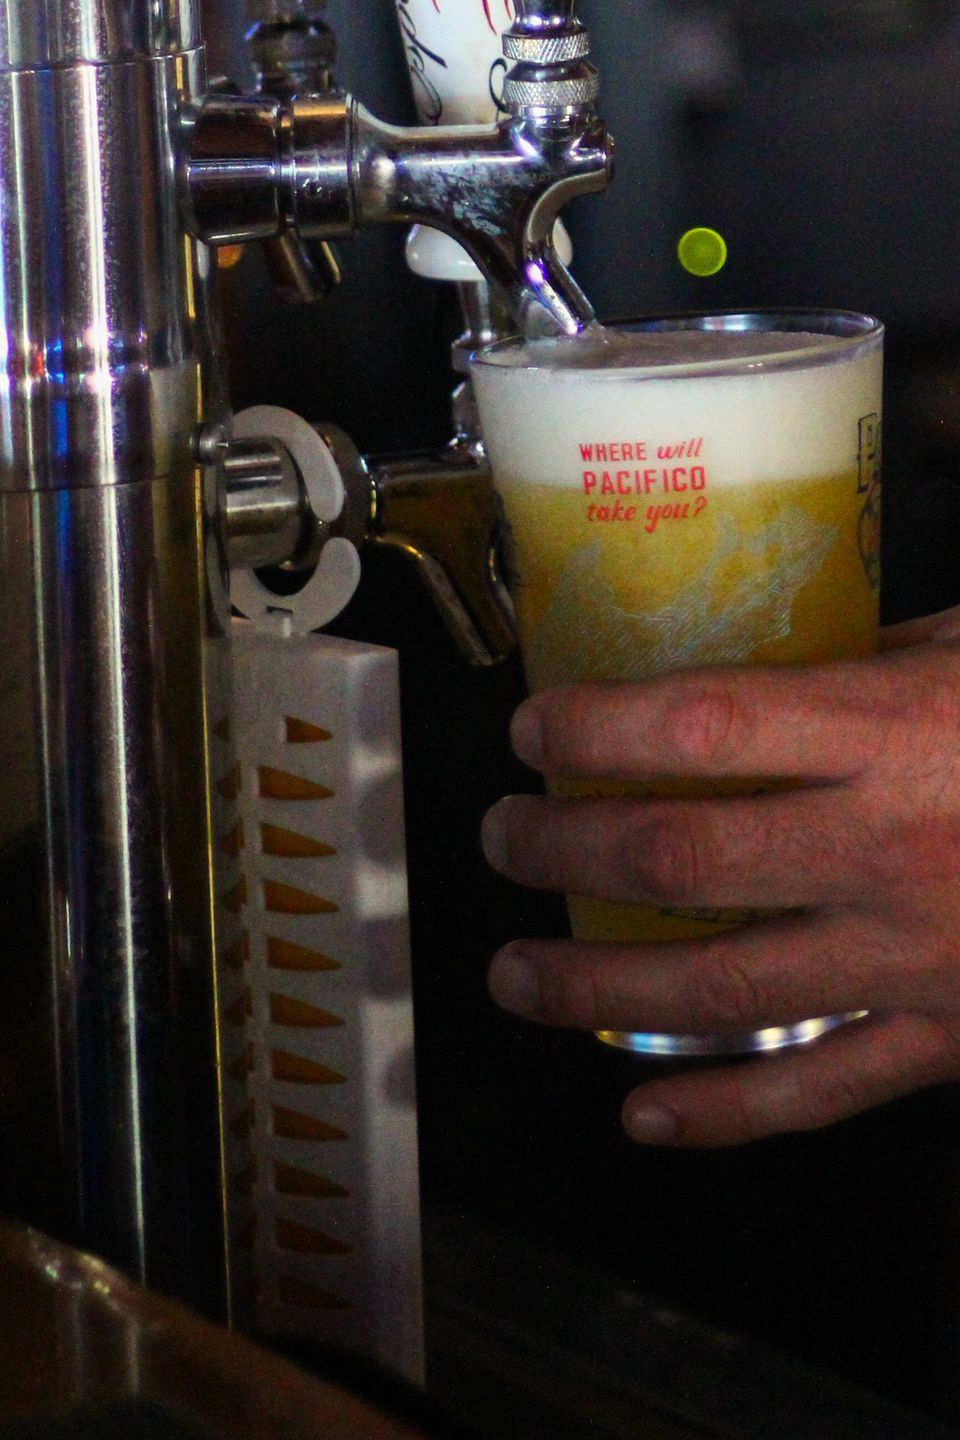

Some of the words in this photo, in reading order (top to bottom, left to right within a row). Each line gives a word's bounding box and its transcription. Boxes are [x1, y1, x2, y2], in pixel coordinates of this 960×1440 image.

[578, 441, 648, 462] WHERE
[656, 437, 704, 460] will
[582, 466, 706, 496] PACIFICO
[586, 499, 636, 523] take
[643, 495, 708, 535] you?
